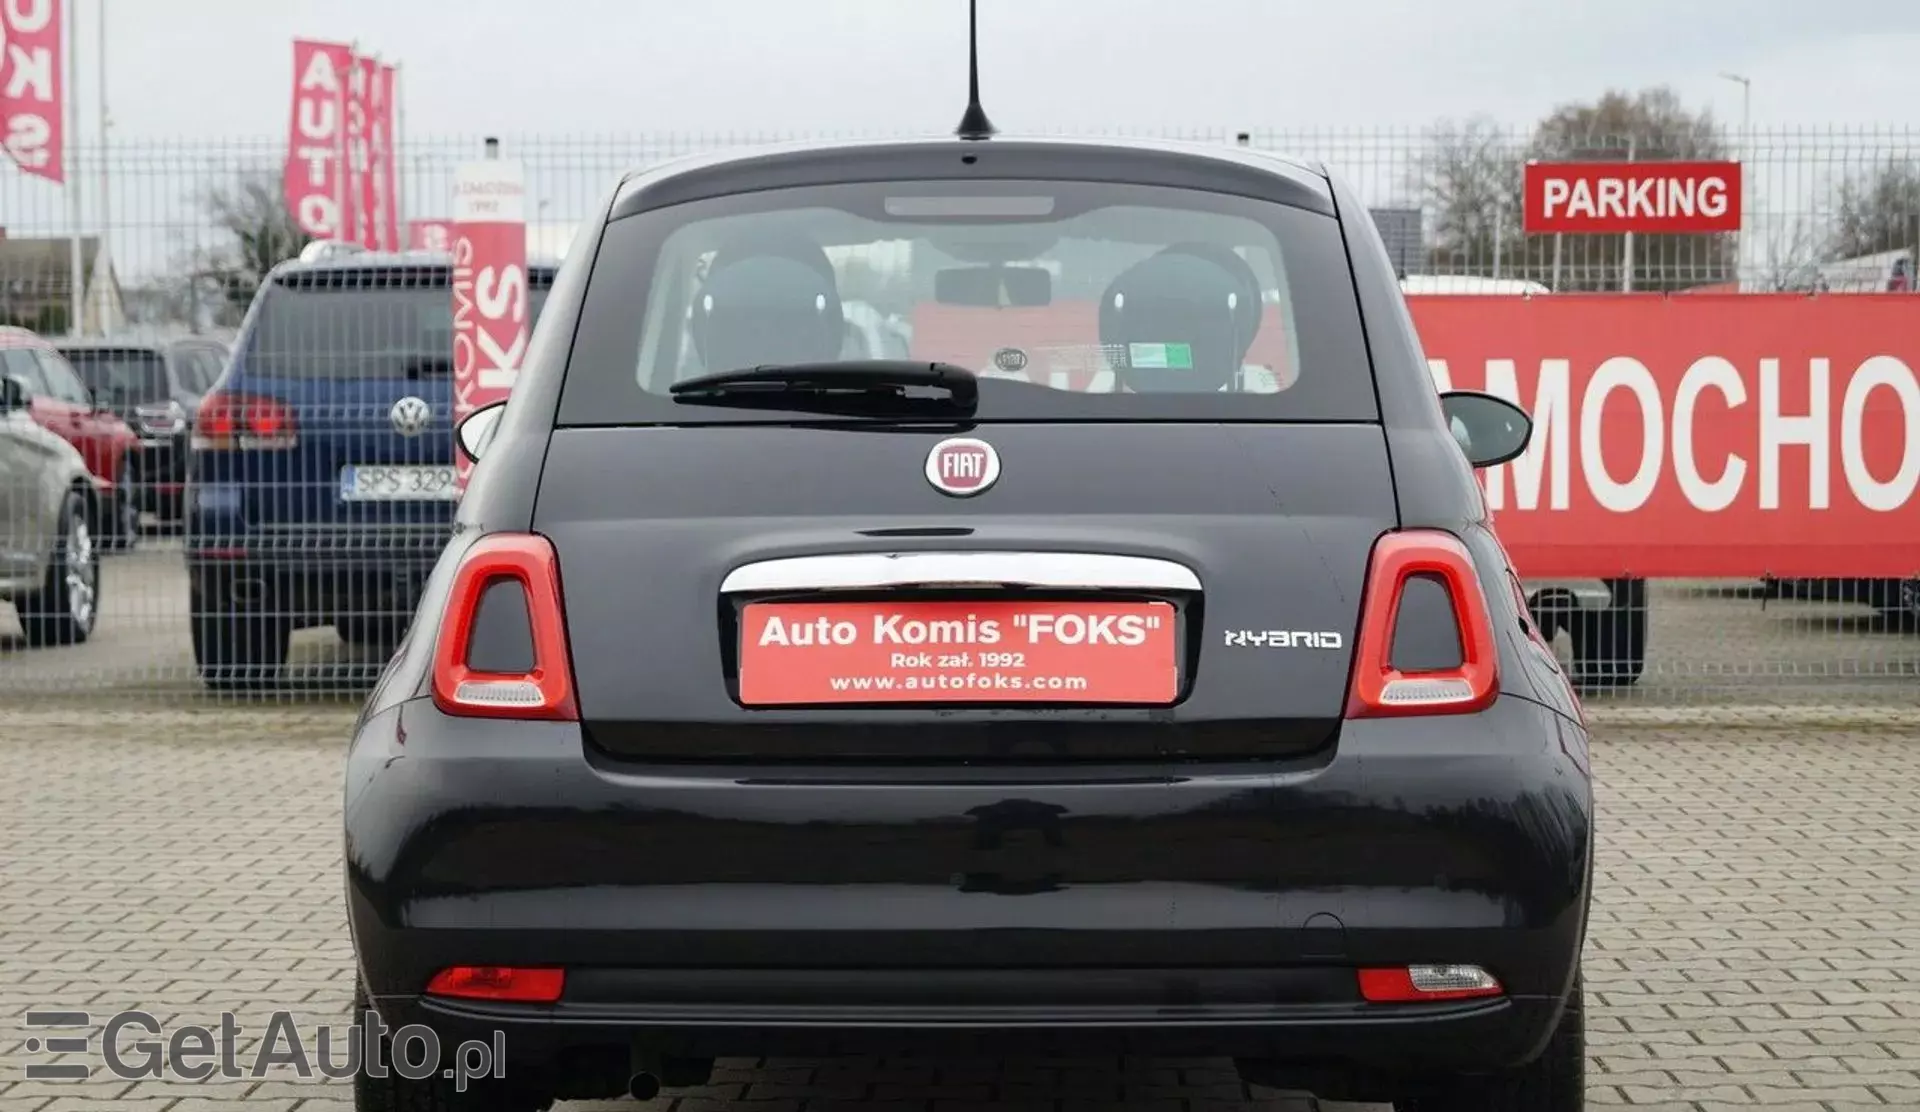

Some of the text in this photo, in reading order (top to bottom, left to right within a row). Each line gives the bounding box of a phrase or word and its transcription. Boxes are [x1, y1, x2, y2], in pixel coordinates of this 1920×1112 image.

[298, 51, 339, 235] AUTO
[1543, 177, 1728, 218] PARKING
[453, 236, 476, 413] KOMIS
[1427, 355, 1920, 512] MOCHO
[943, 452, 984, 478] FIAT
[356, 468, 401, 493] SPS
[408, 468, 456, 493] 329
[758, 613, 1161, 646] Auto Komis "FOKS"
[1224, 629, 1342, 648] HYBRID
[890, 651, 1025, 669] Rok zał. 1992
[830, 672, 1088, 690] www.autofoks.com
